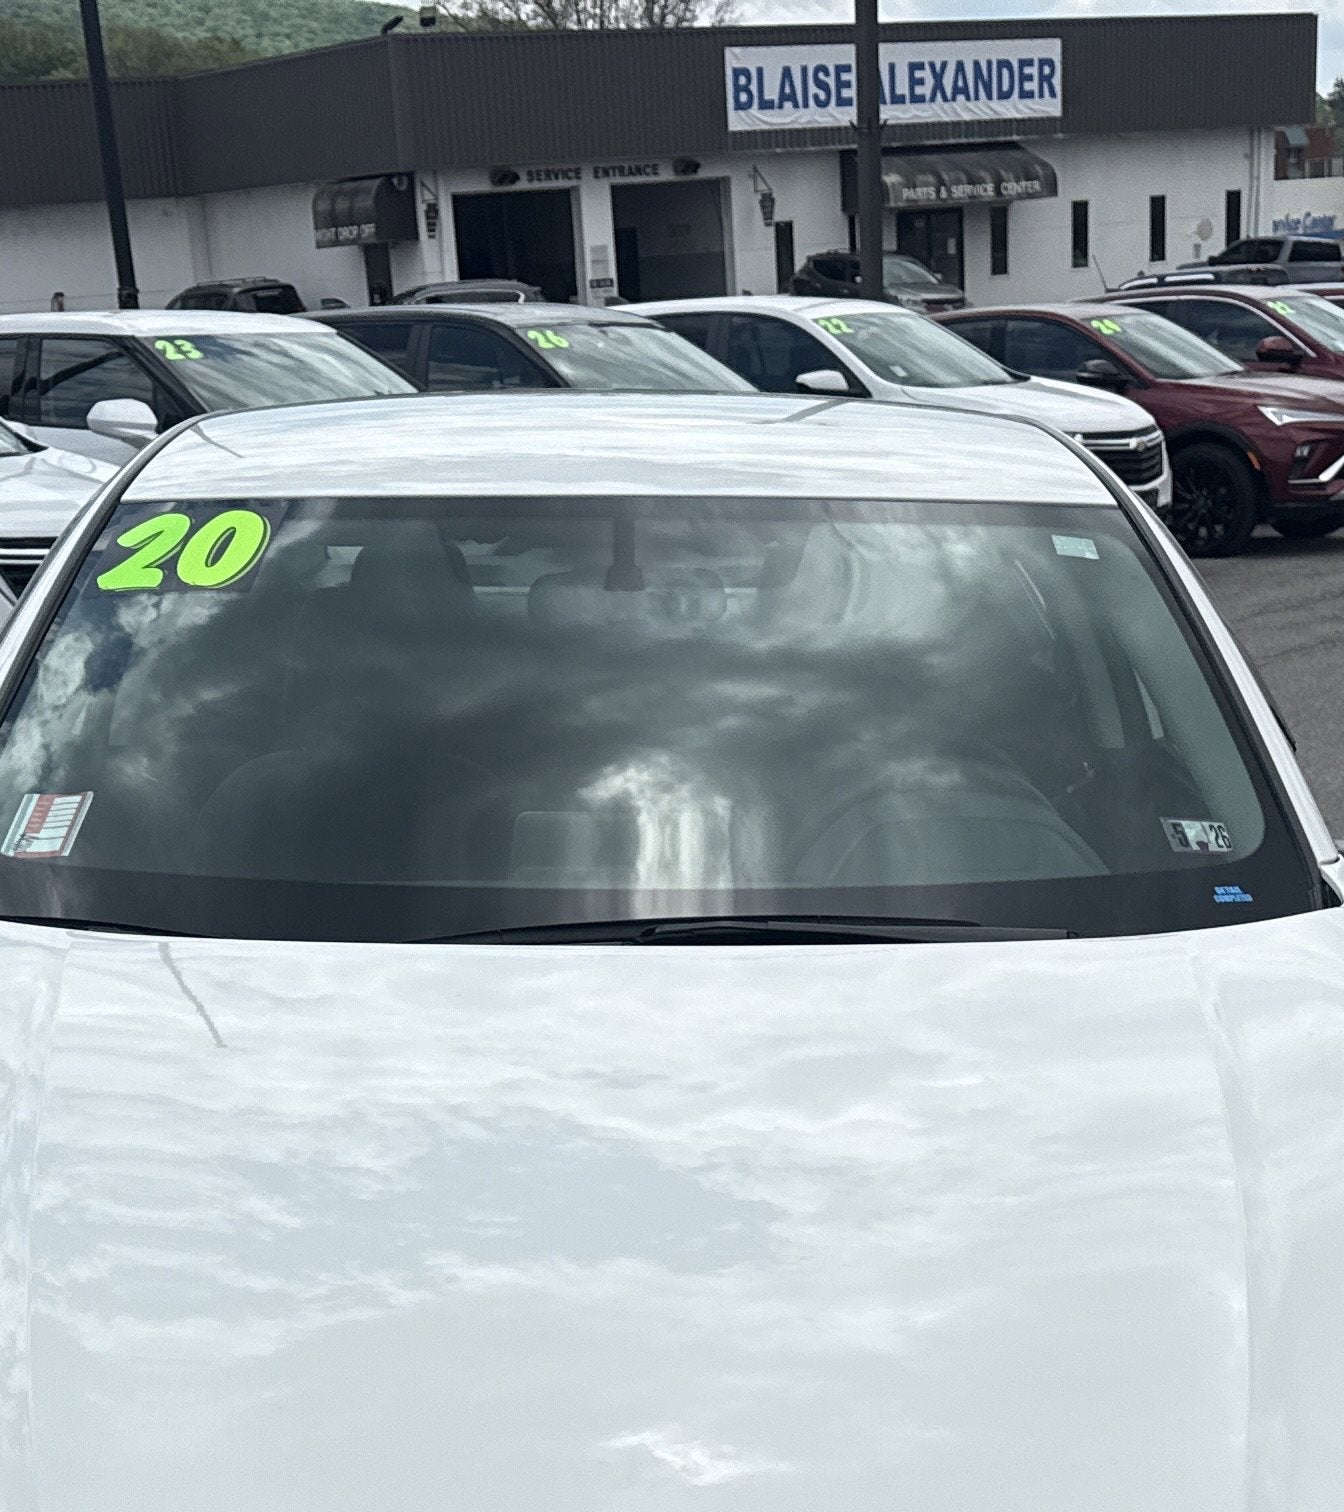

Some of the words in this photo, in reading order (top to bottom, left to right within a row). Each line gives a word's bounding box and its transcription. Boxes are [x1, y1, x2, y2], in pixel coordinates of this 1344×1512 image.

[731, 63, 854, 112] BLAISE
[526, 166, 582, 183] SERVICE
[592, 163, 660, 180] ENTRANCE
[902, 186, 937, 200] PARTS
[950, 183, 995, 198] SERVICE
[1000, 180, 1042, 196] CENTER
[154, 339, 204, 360] 23
[527, 329, 570, 349] 26
[96, 509, 272, 591] 20
[1208, 823, 1232, 849] 26
